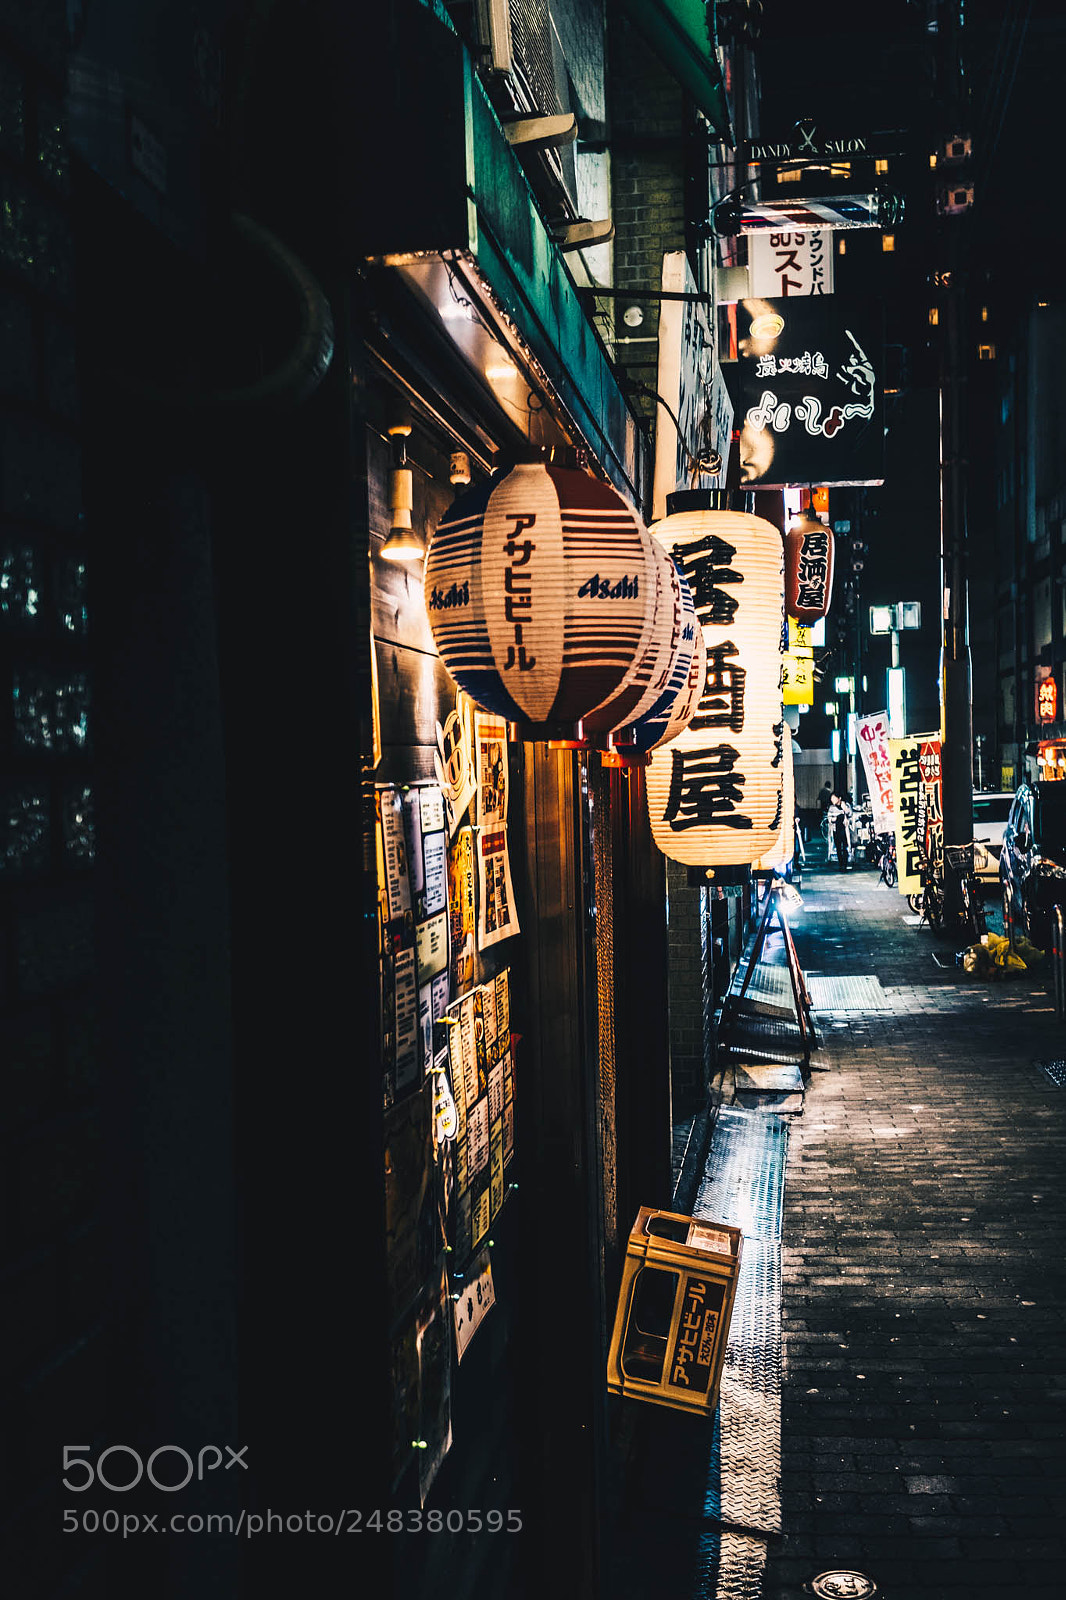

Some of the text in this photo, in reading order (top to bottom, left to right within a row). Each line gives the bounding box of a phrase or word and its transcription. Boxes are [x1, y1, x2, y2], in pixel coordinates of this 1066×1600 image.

[751, 138, 866, 159] DANDY SALON
[503, 513, 536, 671] アサヒビール
[578, 574, 639, 600] Asahi
[796, 532, 829, 609] 居酒屋
[672, 1283, 707, 1385] アサヒビール
